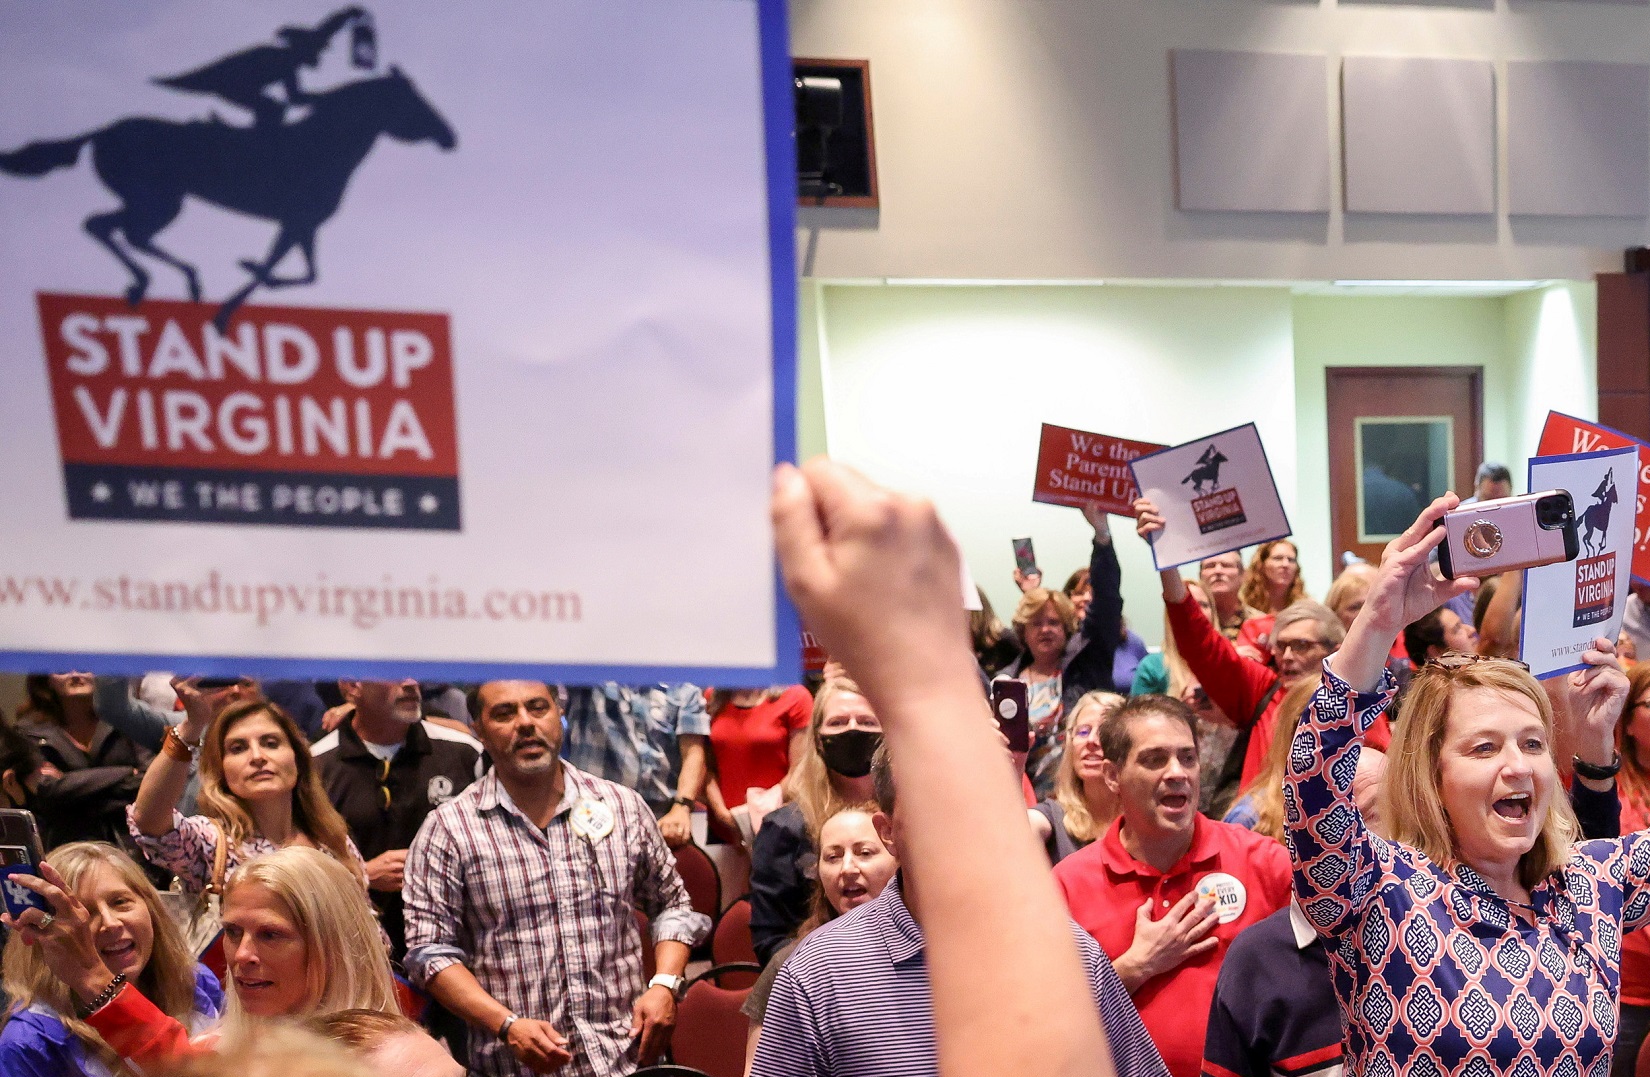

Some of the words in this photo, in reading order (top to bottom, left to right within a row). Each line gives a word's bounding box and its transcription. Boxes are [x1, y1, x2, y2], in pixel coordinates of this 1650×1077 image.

[60, 313, 321, 385] STAND
[332, 326, 435, 388] UP
[74, 385, 435, 461] VIRGINIA
[1070, 433, 1105, 457] We
[1066, 452, 1128, 479] Parent
[128, 480, 185, 510] WE
[199, 481, 262, 512] THE
[272, 483, 404, 516] PEOPLE
[1049, 468, 1106, 496] Stand
[1112, 480, 1140, 506] Up
[1577, 560, 1606, 583] STAND
[1606, 558, 1615, 575] UP
[1577, 579, 1614, 605] VIRGINIA
[1582, 611, 1591, 621] WE
[1591, 610, 1600, 618] THE
[1219, 893, 1238, 906] KID
